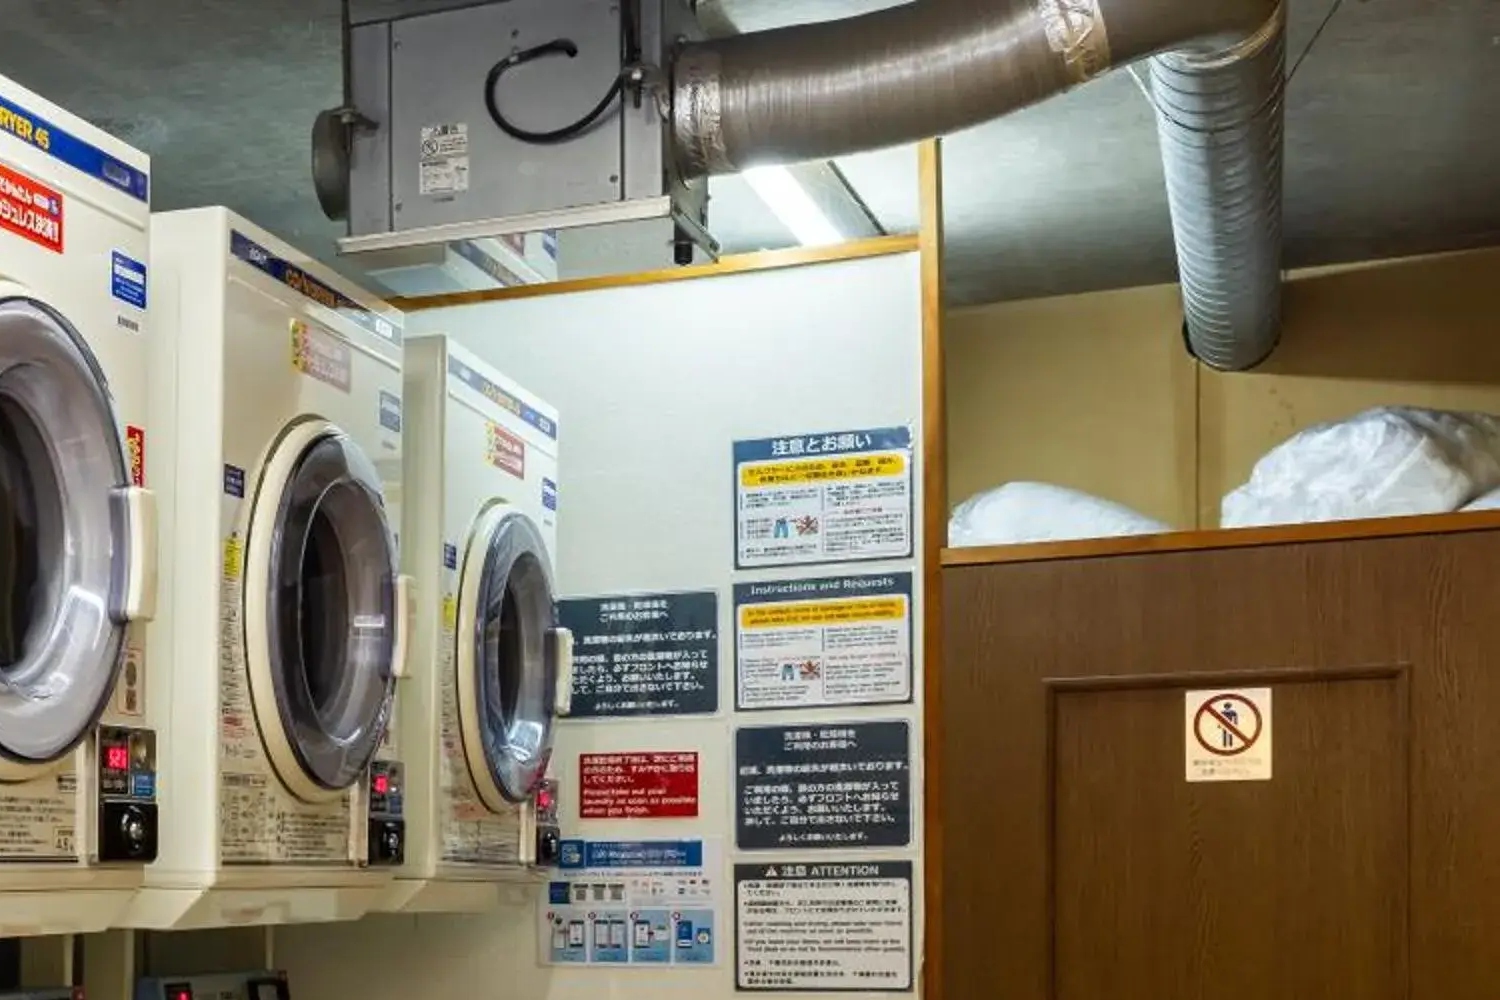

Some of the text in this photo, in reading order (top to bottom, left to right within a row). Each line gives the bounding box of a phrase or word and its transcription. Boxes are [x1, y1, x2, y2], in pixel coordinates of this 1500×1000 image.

[771, 433, 871, 456] 注意とお願い
[810, 865, 880, 877] ATTENTION
